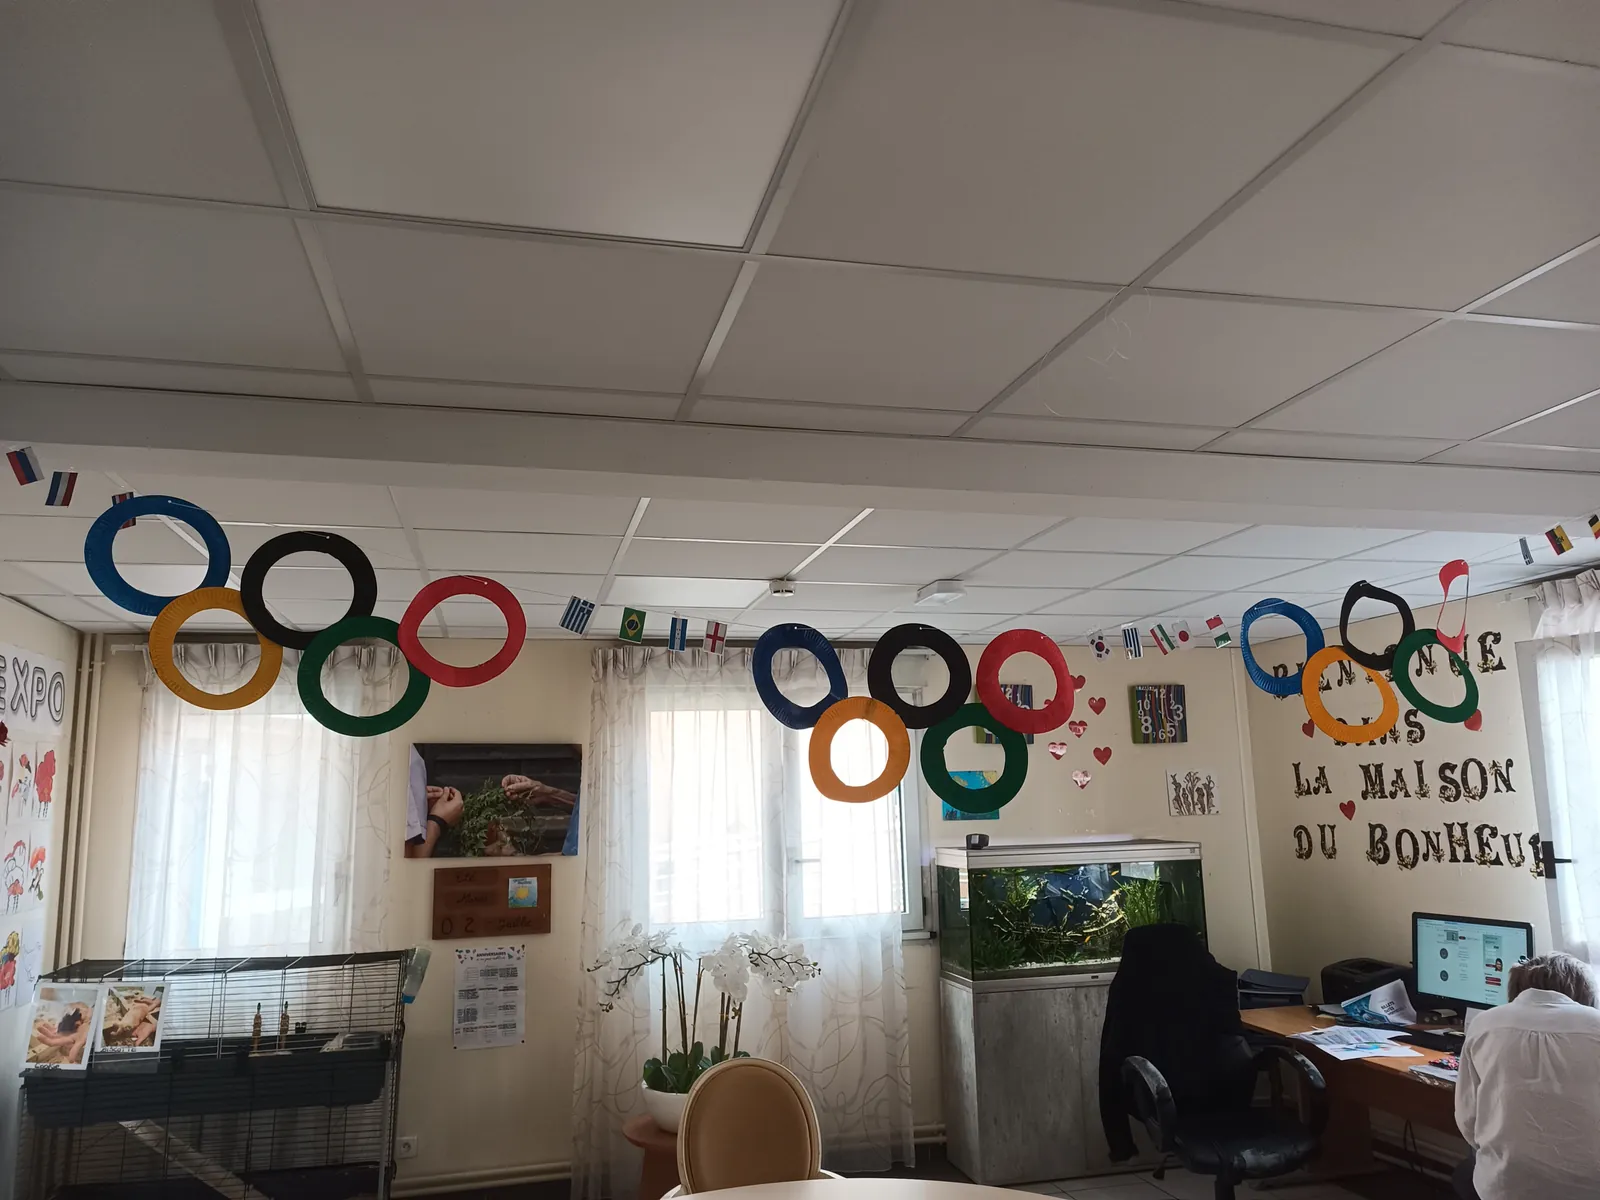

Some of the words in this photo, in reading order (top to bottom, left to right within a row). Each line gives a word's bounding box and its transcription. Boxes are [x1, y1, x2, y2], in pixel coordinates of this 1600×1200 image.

[1137, 699, 1150, 711] 10
[1173, 704, 1184, 720] 3
[1141, 715, 1153, 734] 8
[1166, 722, 1176, 737] 5
[1158, 728, 1166, 740] 6
[1292, 761, 1332, 799] LA
[1358, 757, 1516, 804] MAISON
[1293, 823, 1338, 861] DU
